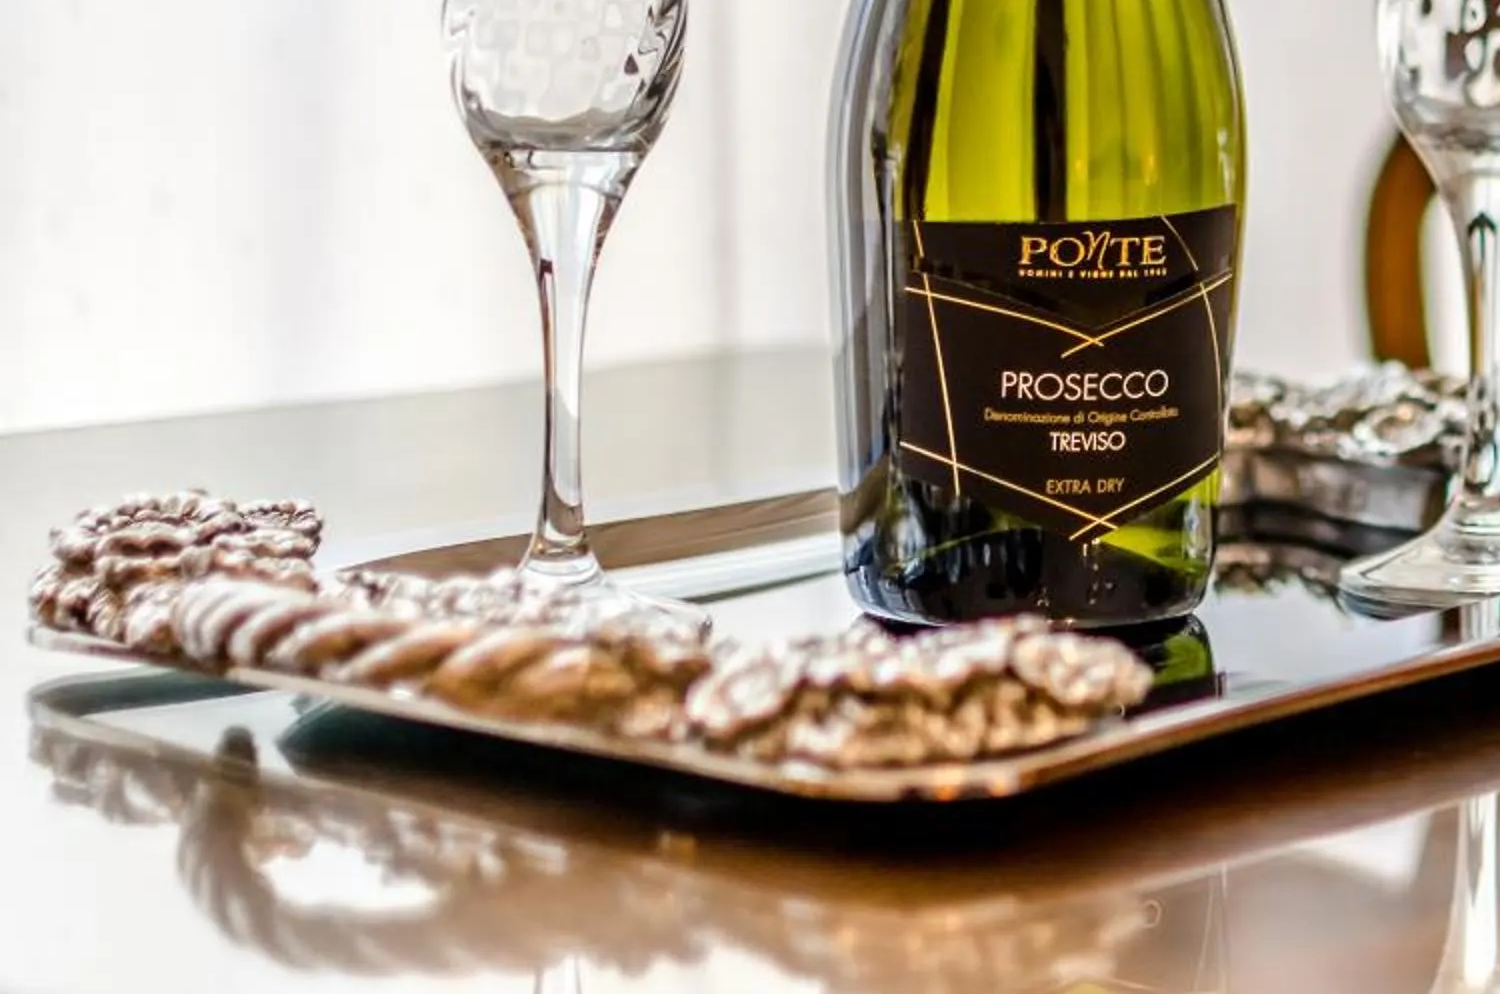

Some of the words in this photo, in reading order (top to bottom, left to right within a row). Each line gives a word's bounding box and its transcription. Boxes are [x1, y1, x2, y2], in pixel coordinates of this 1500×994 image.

[1001, 370, 1169, 401] PROSECCO
[983, 407, 1071, 424] Denominazione
[1073, 410, 1085, 424] di
[1088, 410, 1127, 427] Origine
[1050, 431, 1126, 452] TREVISO
[1046, 479, 1091, 494] EXTRA
[1097, 478, 1125, 493] DRY
